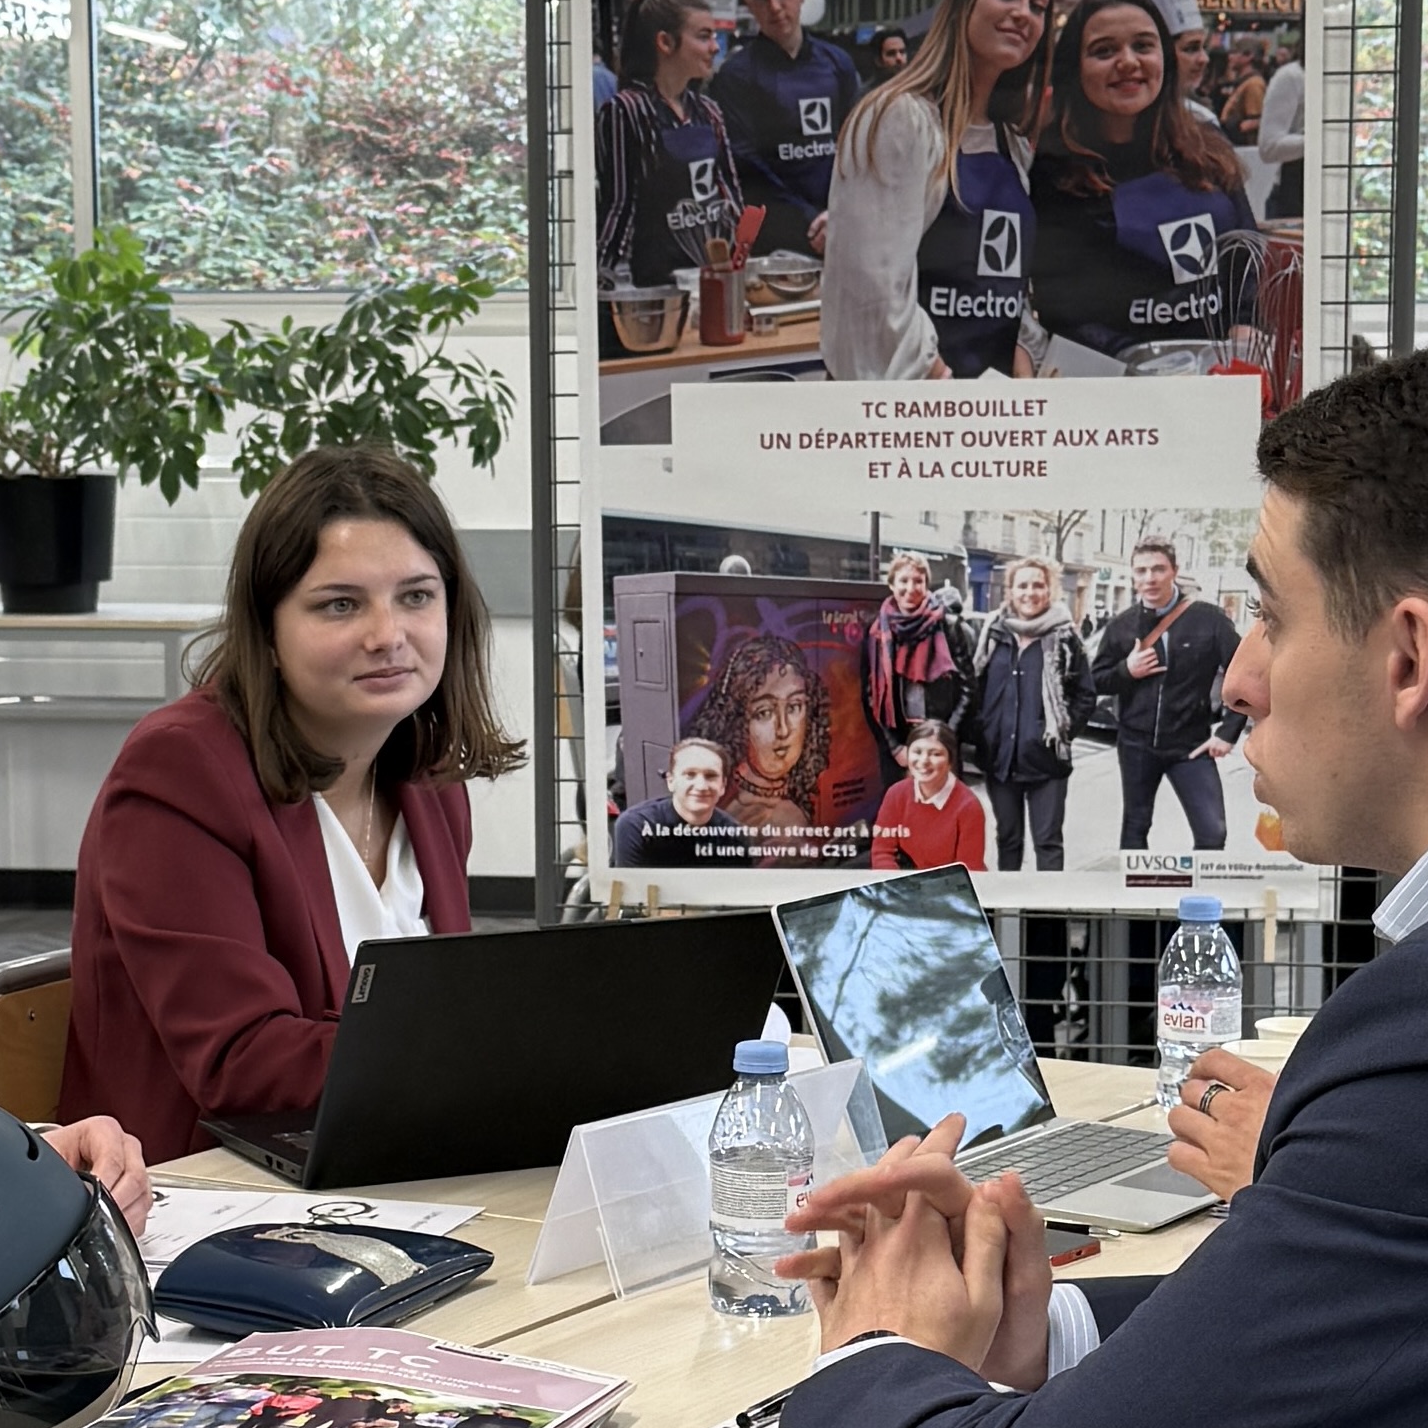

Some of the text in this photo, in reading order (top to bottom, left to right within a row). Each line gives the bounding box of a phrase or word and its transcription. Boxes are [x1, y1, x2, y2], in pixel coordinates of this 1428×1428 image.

[862, 399, 1048, 418] TC RAMBOUILLET
[760, 428, 1159, 450] UN DÉPARTEMENT OUVERT AUX ARTS
[869, 458, 1048, 479] ET À LA CULTURE
[642, 821, 910, 838] À la découverte du street art à Paris
[695, 843, 713, 857] Ici
[716, 846, 744, 857] une
[822, 844, 857, 857] C215
[1127, 855, 1186, 873] UVSQ
[1163, 1012, 1206, 1028] evian
[222, 1345, 346, 1359] BUT
[368, 1347, 440, 1370] TC
